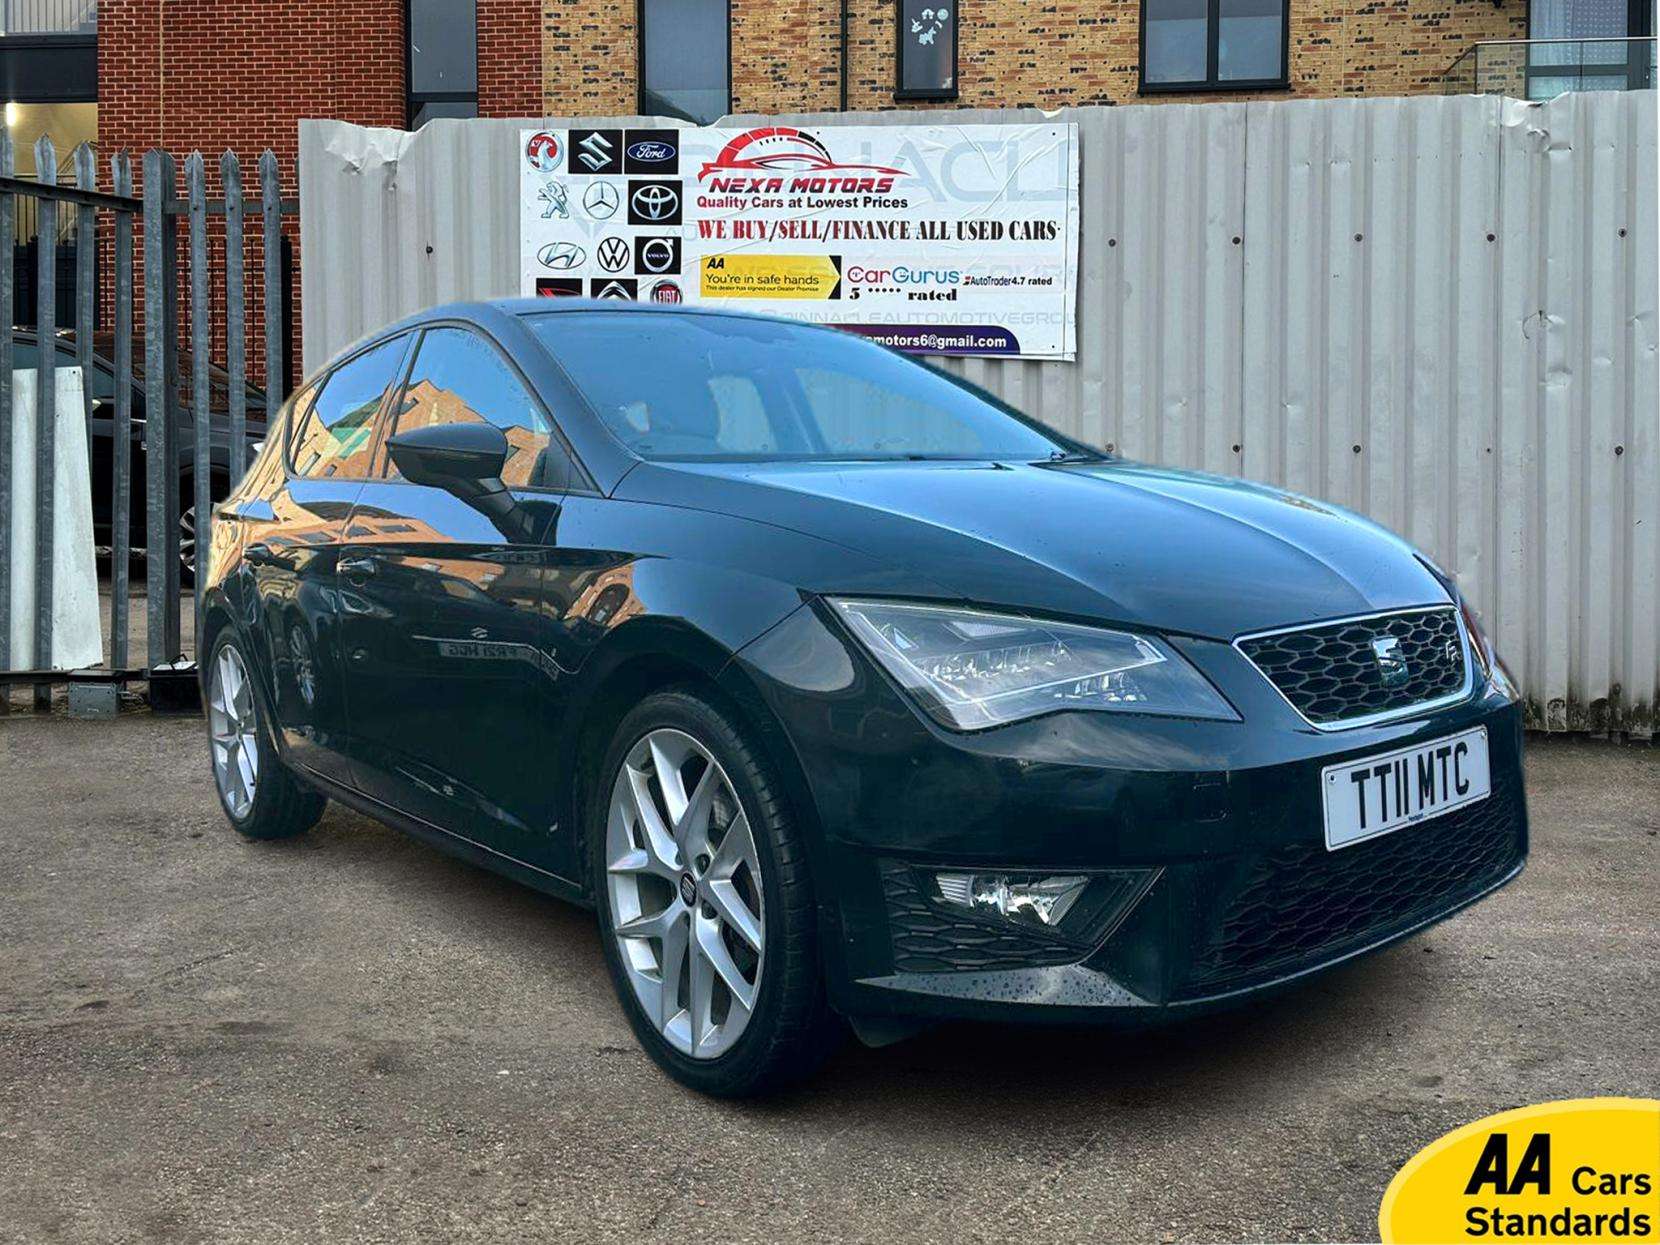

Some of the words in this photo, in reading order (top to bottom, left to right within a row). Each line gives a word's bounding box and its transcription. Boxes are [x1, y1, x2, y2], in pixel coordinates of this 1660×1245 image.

[636, 144, 666, 158] Ford
[709, 178, 784, 193] NEXA
[789, 178, 895, 193] MOTORS
[697, 196, 747, 211] Quality
[751, 196, 784, 208] Cars
[788, 197, 802, 208] at
[807, 197, 859, 208] Lowest
[863, 197, 908, 208] Prices
[697, 220, 726, 240] WE
[916, 221, 951, 240] ALL
[956, 221, 1004, 241] USED
[1008, 221, 1057, 240] CARS
[707, 258, 725, 269] AA
[706, 274, 741, 284] You're
[744, 275, 754, 284] in
[757, 274, 780, 285] safe
[783, 275, 819, 285] hands
[847, 266, 960, 283] CarGurus
[1028, 277, 1052, 285] rated
[658, 290, 676, 305] FIAT
[849, 287, 860, 300] 5
[908, 288, 957, 301] rated
[1351, 758, 1410, 829] TT11
[1417, 741, 1470, 810] MTC
